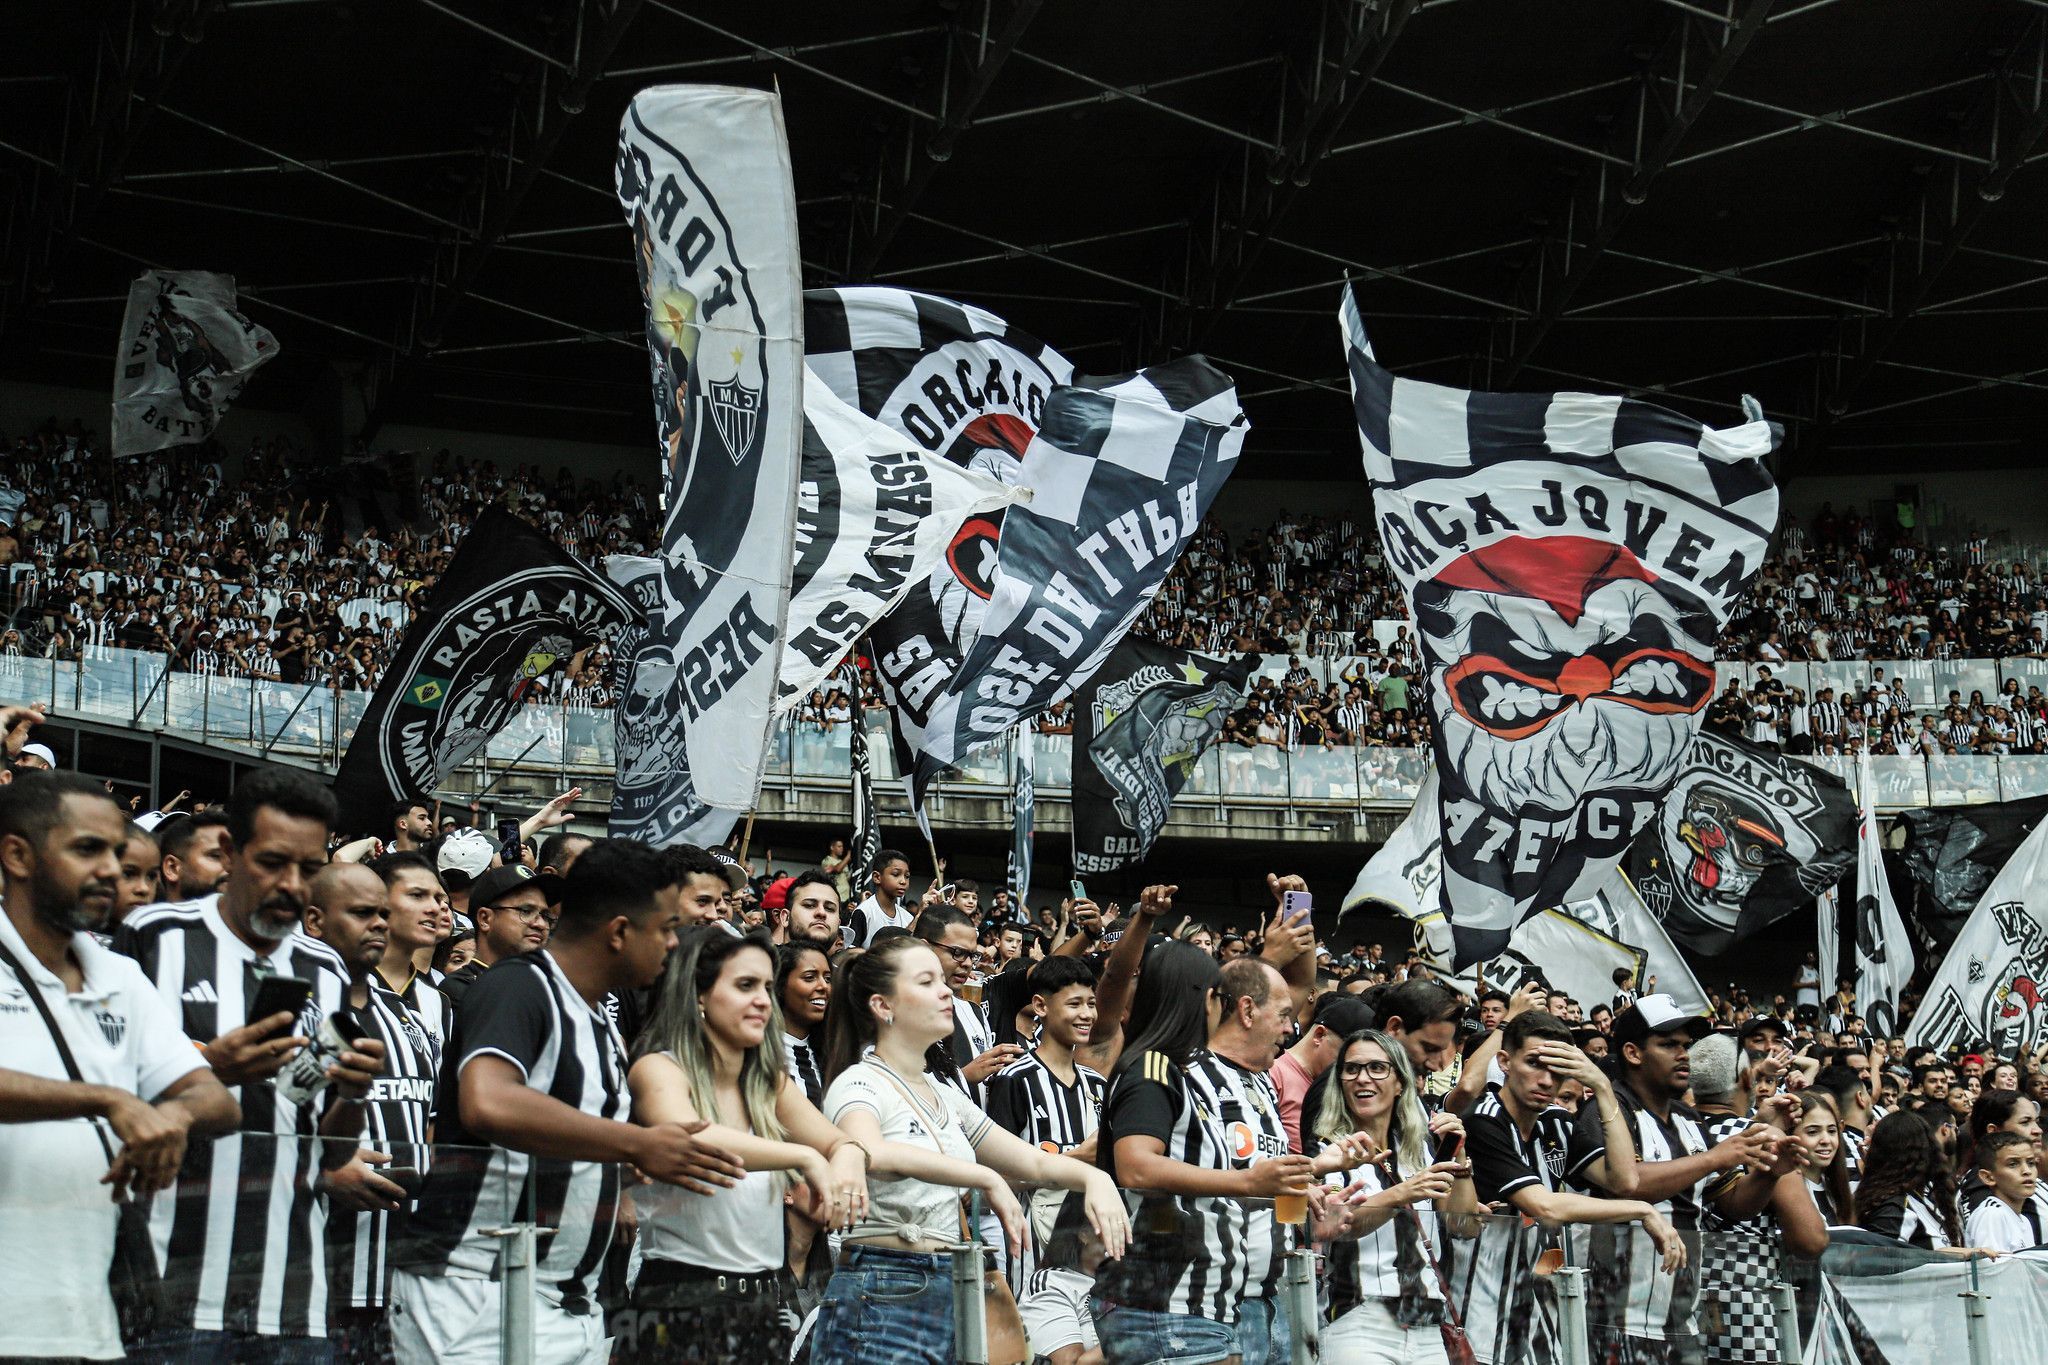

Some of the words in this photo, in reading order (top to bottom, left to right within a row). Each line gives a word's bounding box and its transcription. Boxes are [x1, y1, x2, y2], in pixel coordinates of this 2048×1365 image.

[900, 358, 1012, 452] ORÇA
[847, 451, 934, 604] MNAS!
[432, 588, 543, 669] RASTA
[558, 588, 622, 641] ATLE
[882, 634, 958, 712] SÃ
[1103, 835, 1140, 855] GAL
[1257, 1133, 1289, 1157] BETA
